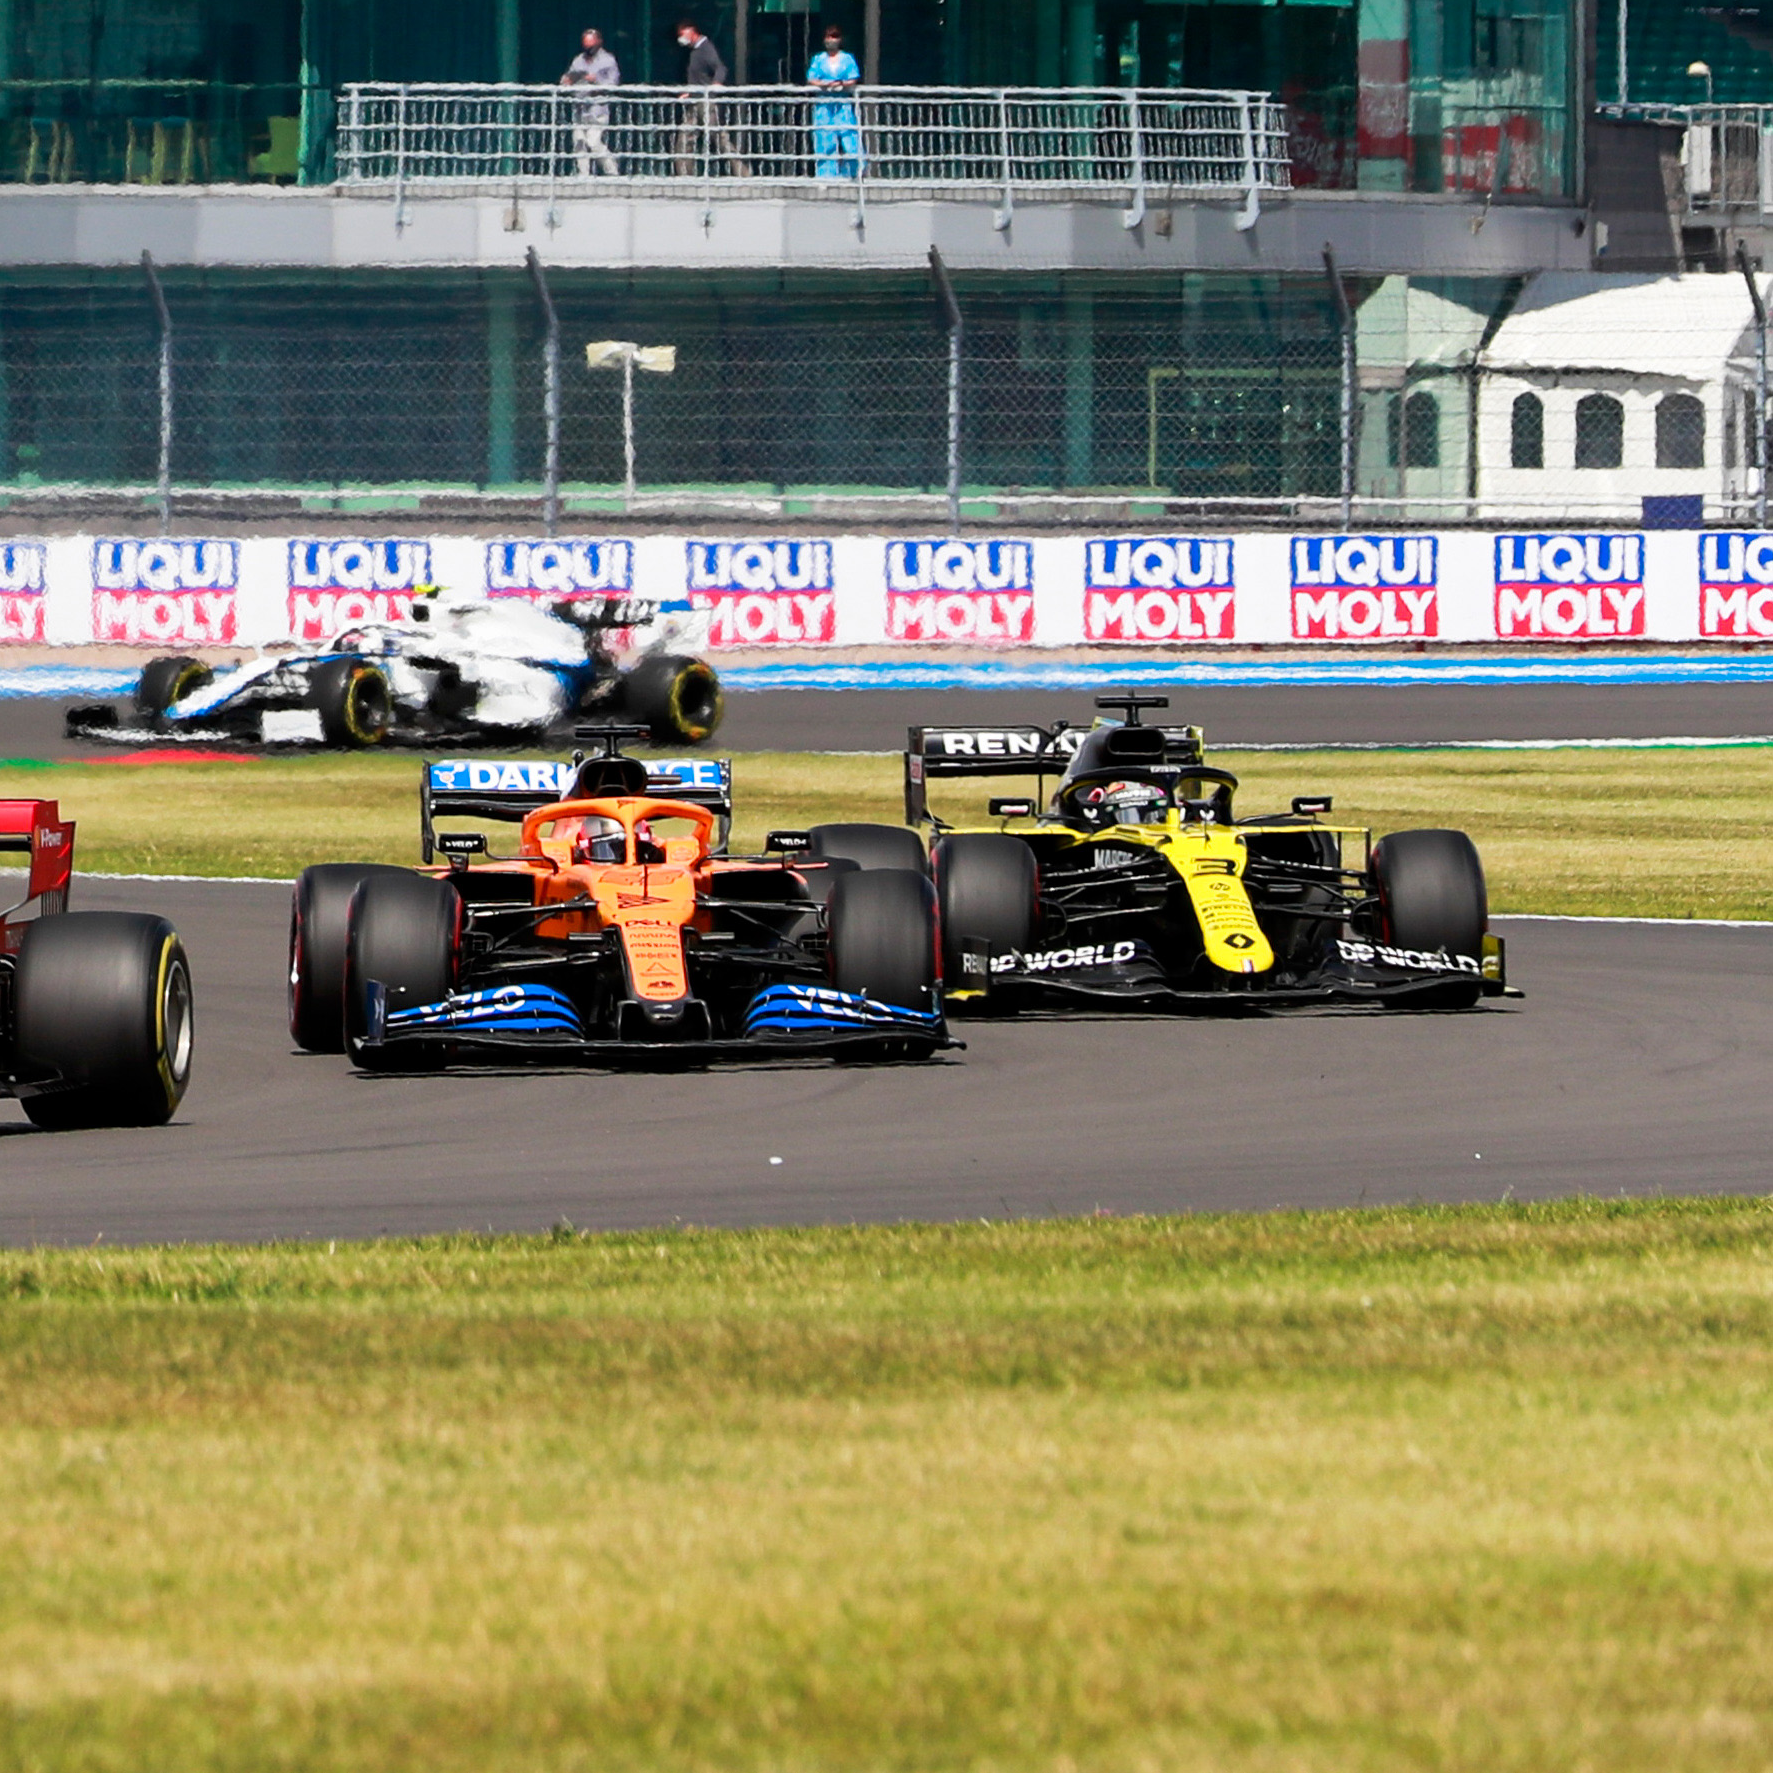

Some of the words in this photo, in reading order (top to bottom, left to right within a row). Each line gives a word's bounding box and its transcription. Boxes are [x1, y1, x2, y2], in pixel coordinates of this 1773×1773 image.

[96, 541, 237, 590] LIQUI
[291, 541, 429, 590] LIQUI
[489, 542, 631, 591] LIQUI
[688, 541, 831, 591] LIQUI
[889, 542, 1032, 591] LIQUI
[1090, 541, 1231, 587] LIQUI
[1294, 538, 1435, 586] LIQUI
[1499, 536, 1641, 584] LIQUI
[95, 594, 237, 642] MOLY
[892, 592, 1033, 638] MOLY
[1090, 591, 1233, 638] MOLY
[1295, 590, 1436, 636] MOLY
[1500, 588, 1643, 635] MOLY
[1192, 858, 1237, 876] 3
[1024, 940, 1136, 971] WORLD
[1336, 939, 1375, 962] DP
[1375, 945, 1482, 975] WORLD
